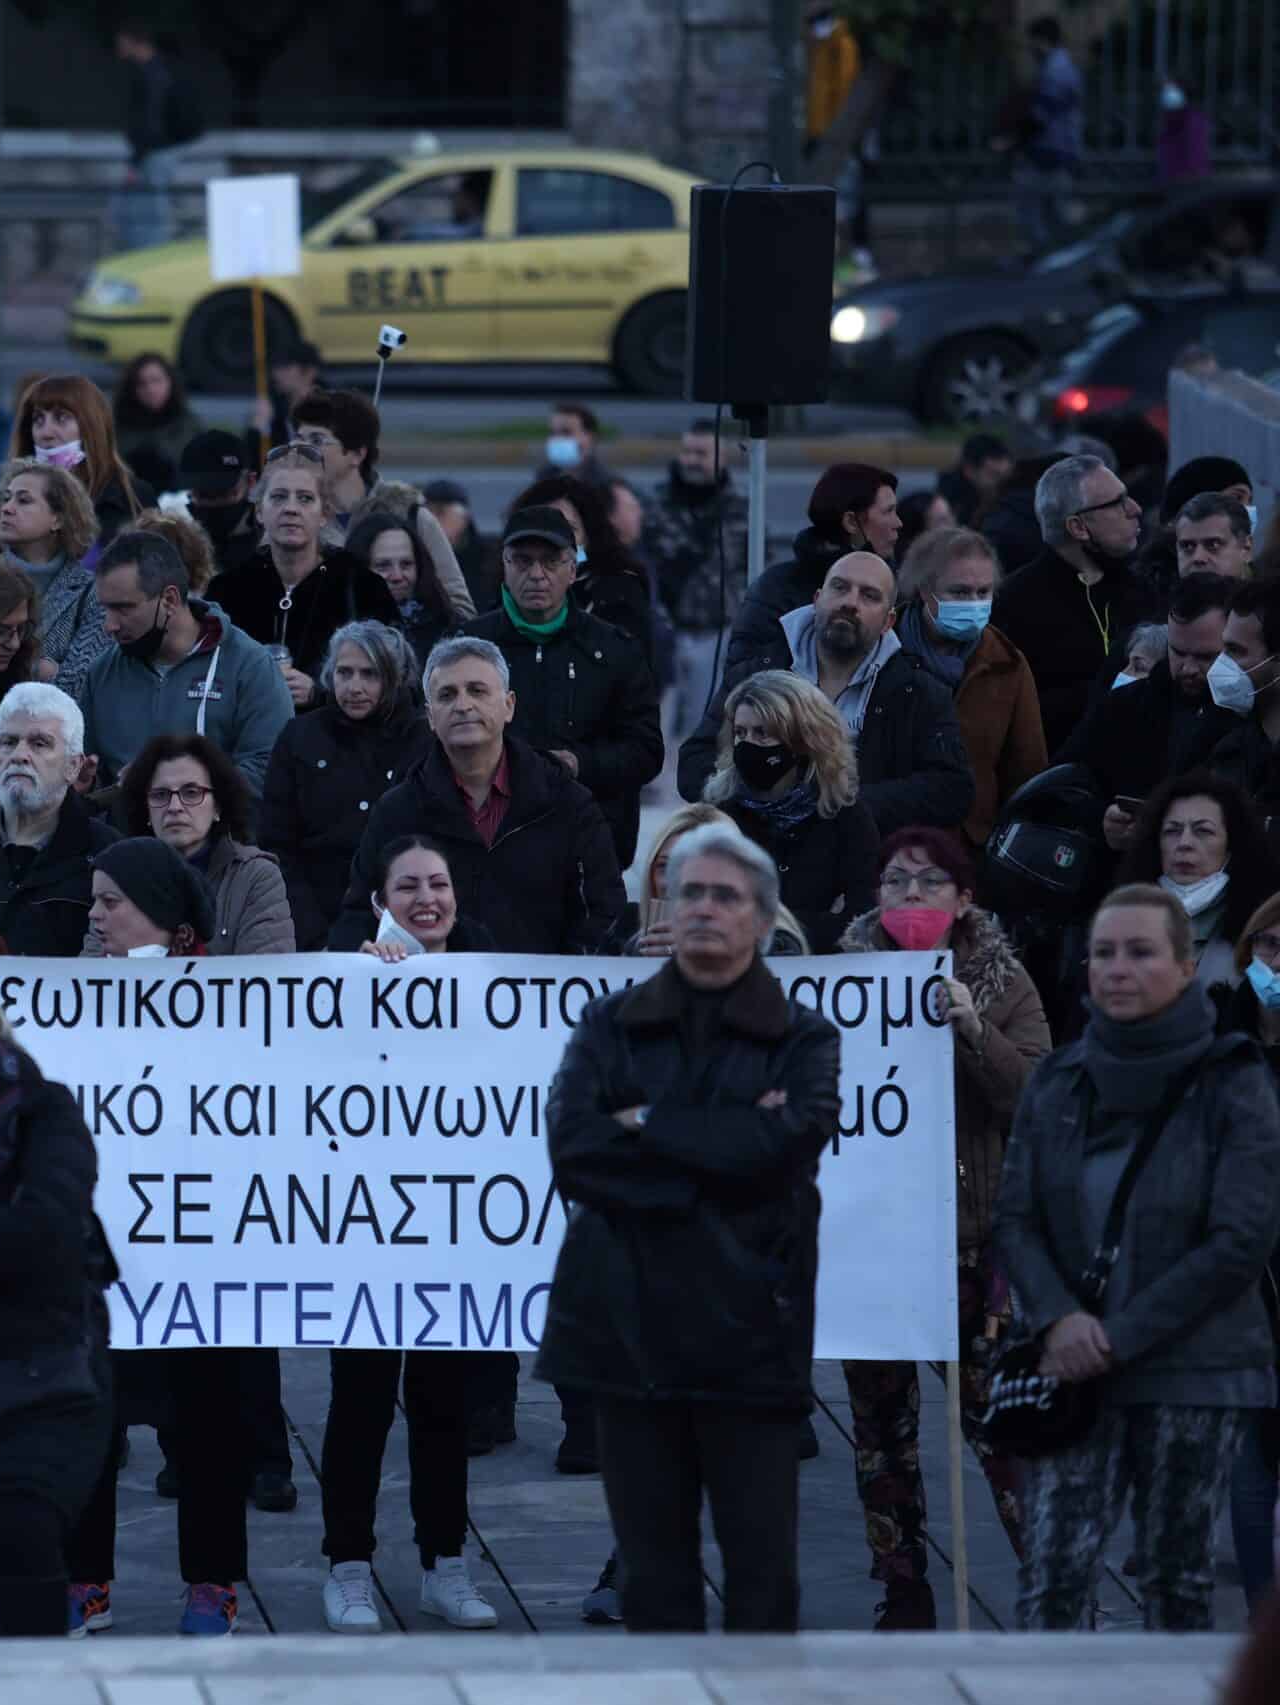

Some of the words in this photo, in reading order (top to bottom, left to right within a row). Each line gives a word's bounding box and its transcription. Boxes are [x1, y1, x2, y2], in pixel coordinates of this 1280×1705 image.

[347, 267, 447, 305] BEAT
[372, 976, 458, 1029] και
[190, 1083, 276, 1137] και
[127, 1173, 214, 1244] ΣΕ
[233, 1173, 569, 1247] ΑΝΑΣΤΟΛ
